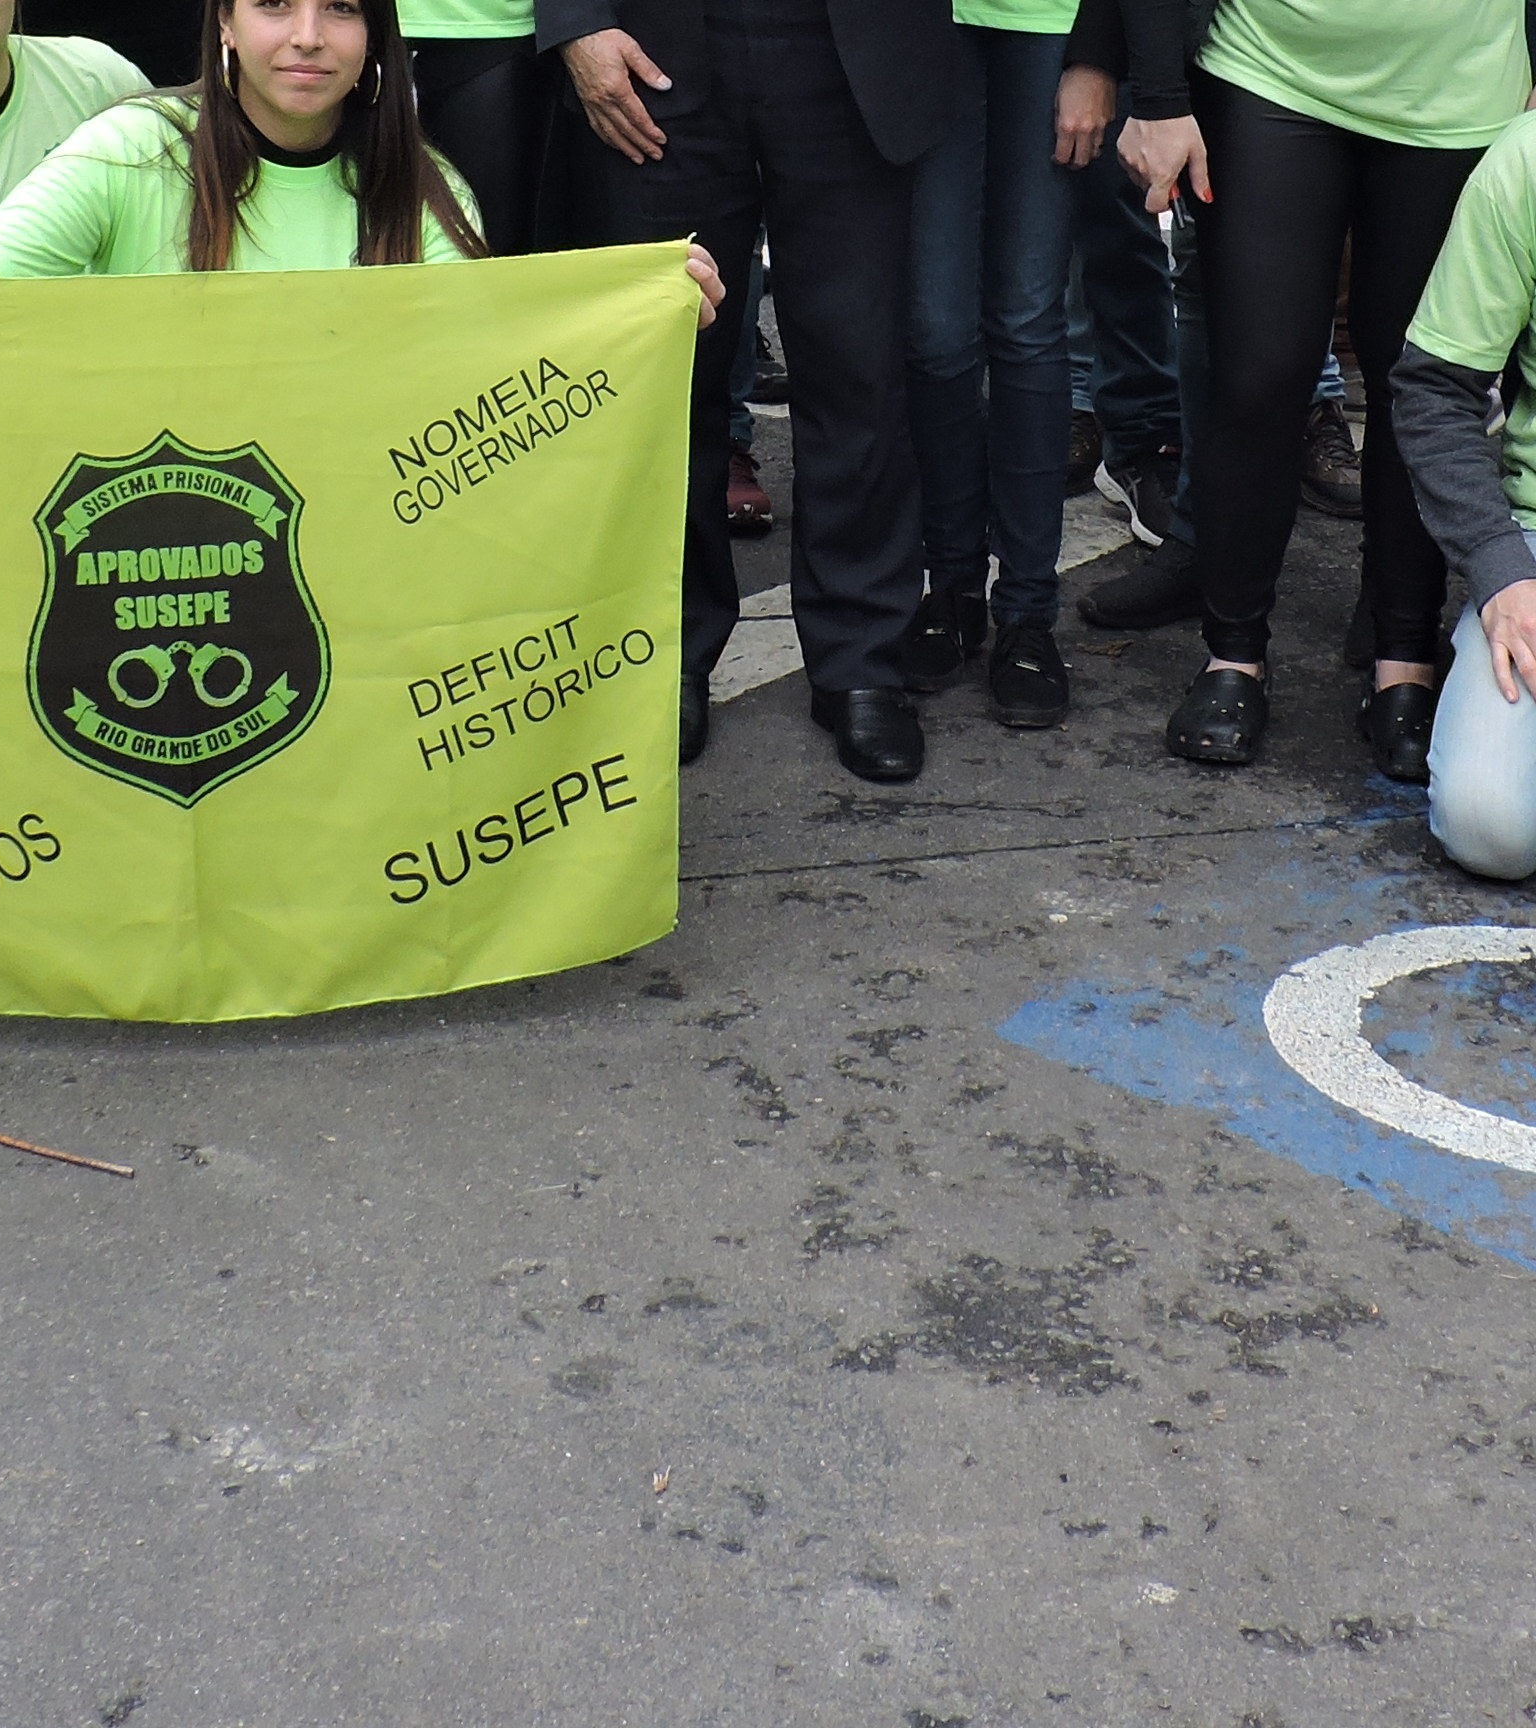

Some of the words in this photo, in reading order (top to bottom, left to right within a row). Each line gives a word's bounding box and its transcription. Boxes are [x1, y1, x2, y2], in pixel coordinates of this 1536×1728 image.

[387, 356, 570, 481] NOMEIA
[393, 368, 619, 525] GOVERNADOR
[81, 471, 159, 518] SISTEMA
[163, 470, 253, 508] PRISIONAL
[76, 539, 264, 586] APROVADOS
[114, 590, 231, 631] SUSEPE
[407, 614, 582, 720] DEFICIT
[417, 628, 655, 772] HISTÓRICO
[95, 720, 127, 746] RIO
[131, 735, 203, 760] GRANDE
[206, 731, 233, 754] DO
[236, 712, 271, 738] SUL
[383, 753, 638, 906] SUSEPE
